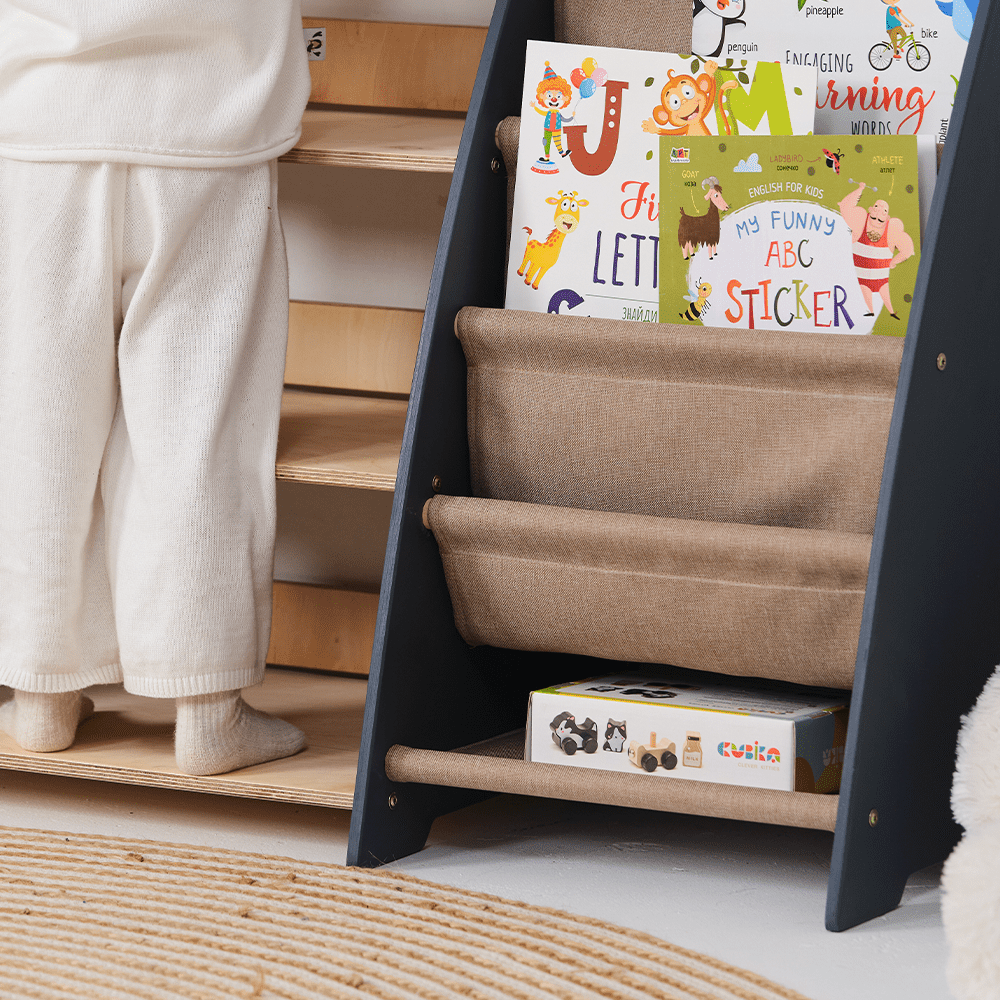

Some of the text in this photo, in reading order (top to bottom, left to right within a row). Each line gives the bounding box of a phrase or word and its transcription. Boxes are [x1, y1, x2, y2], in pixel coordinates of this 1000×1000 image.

[805, 5, 844, 18] pineapple
[921, 28, 939, 39] bike
[727, 41, 759, 55] penguin
[714, 60, 793, 135] M
[815, 76, 936, 135] rning
[563, 79, 629, 176] J
[851, 120, 892, 135] WORDS
[769, 153, 804, 163] LADYBIRD
[871, 155, 904, 165] ATHLETE
[681, 169, 700, 179] GOAT
[748, 181, 824, 199] ENGLISH FOR KIDS
[620, 180, 659, 222] Fi
[735, 210, 836, 239] MY FUNNY
[764, 239, 814, 268] ABC
[724, 278, 855, 330] STICKER
[621, 305, 658, 323] ЗНАЙДИ
